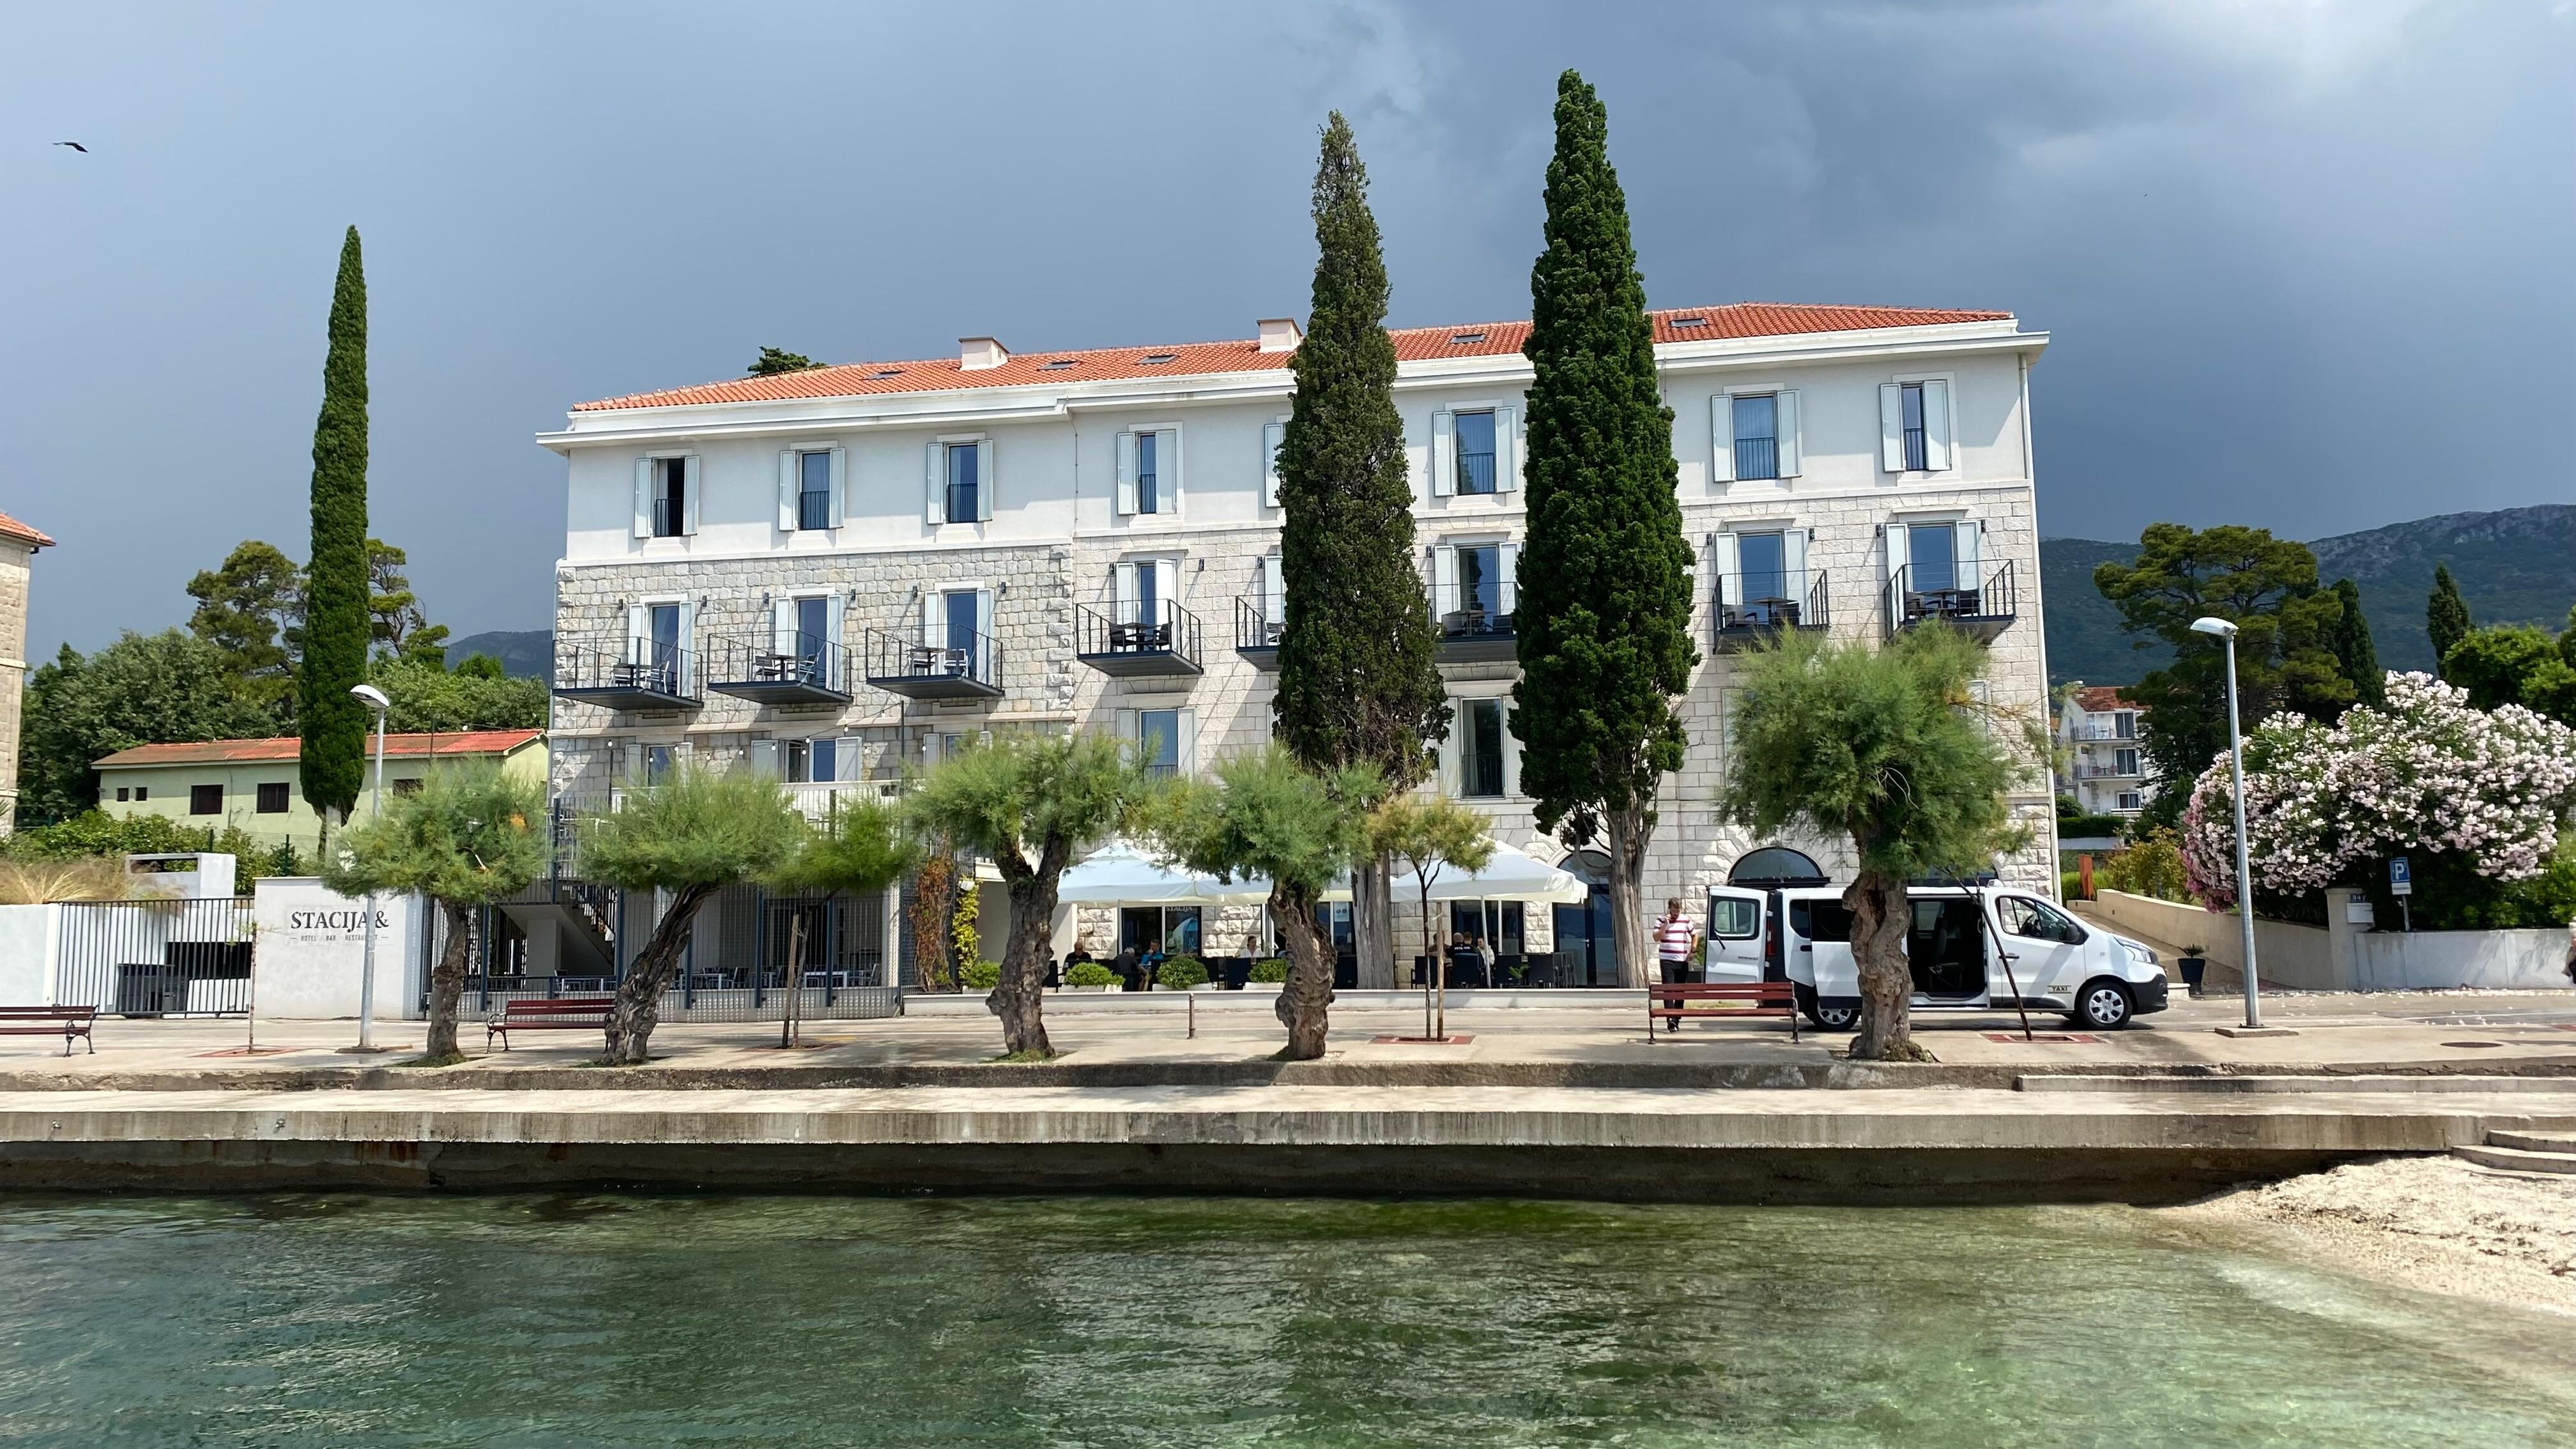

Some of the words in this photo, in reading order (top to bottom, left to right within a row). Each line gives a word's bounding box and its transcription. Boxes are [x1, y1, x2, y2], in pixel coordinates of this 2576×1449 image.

[2395, 862, 2405, 880] P
[291, 911, 367, 933] STACIJA
[376, 910, 390, 928] &
